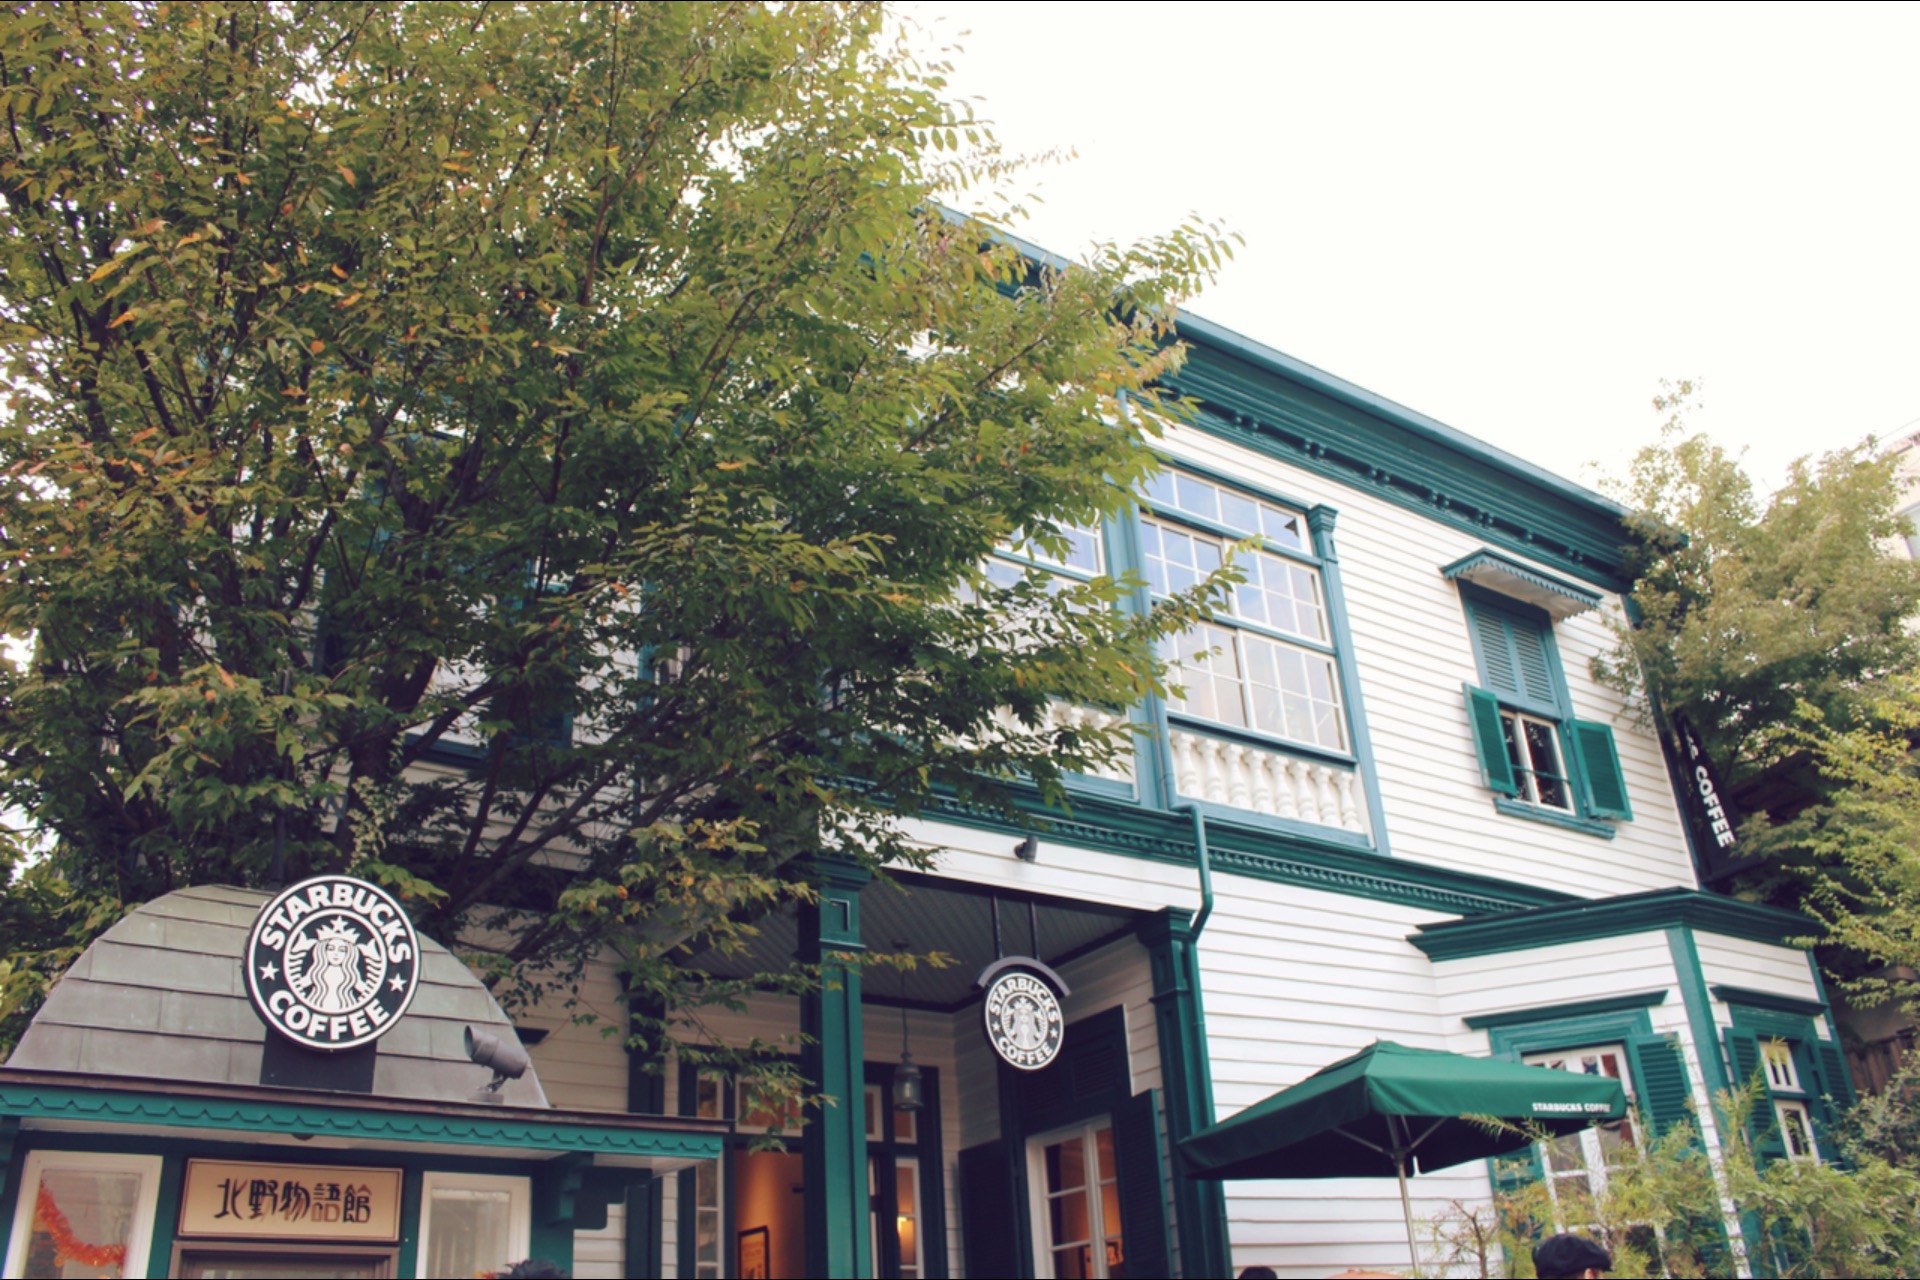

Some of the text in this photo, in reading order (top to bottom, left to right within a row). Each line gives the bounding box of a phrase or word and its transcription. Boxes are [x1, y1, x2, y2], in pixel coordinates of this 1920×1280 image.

[1696, 765, 1736, 847] COFFEE
[260, 883, 411, 963] STARBUCKS
[269, 989, 390, 1040] COFFEE
[989, 977, 1059, 1023] STARBUCKS
[998, 1036, 1054, 1065] COFFEE
[1532, 1102, 1583, 1112] STARBUCKS
[213, 1177, 373, 1224] 北野物語館
